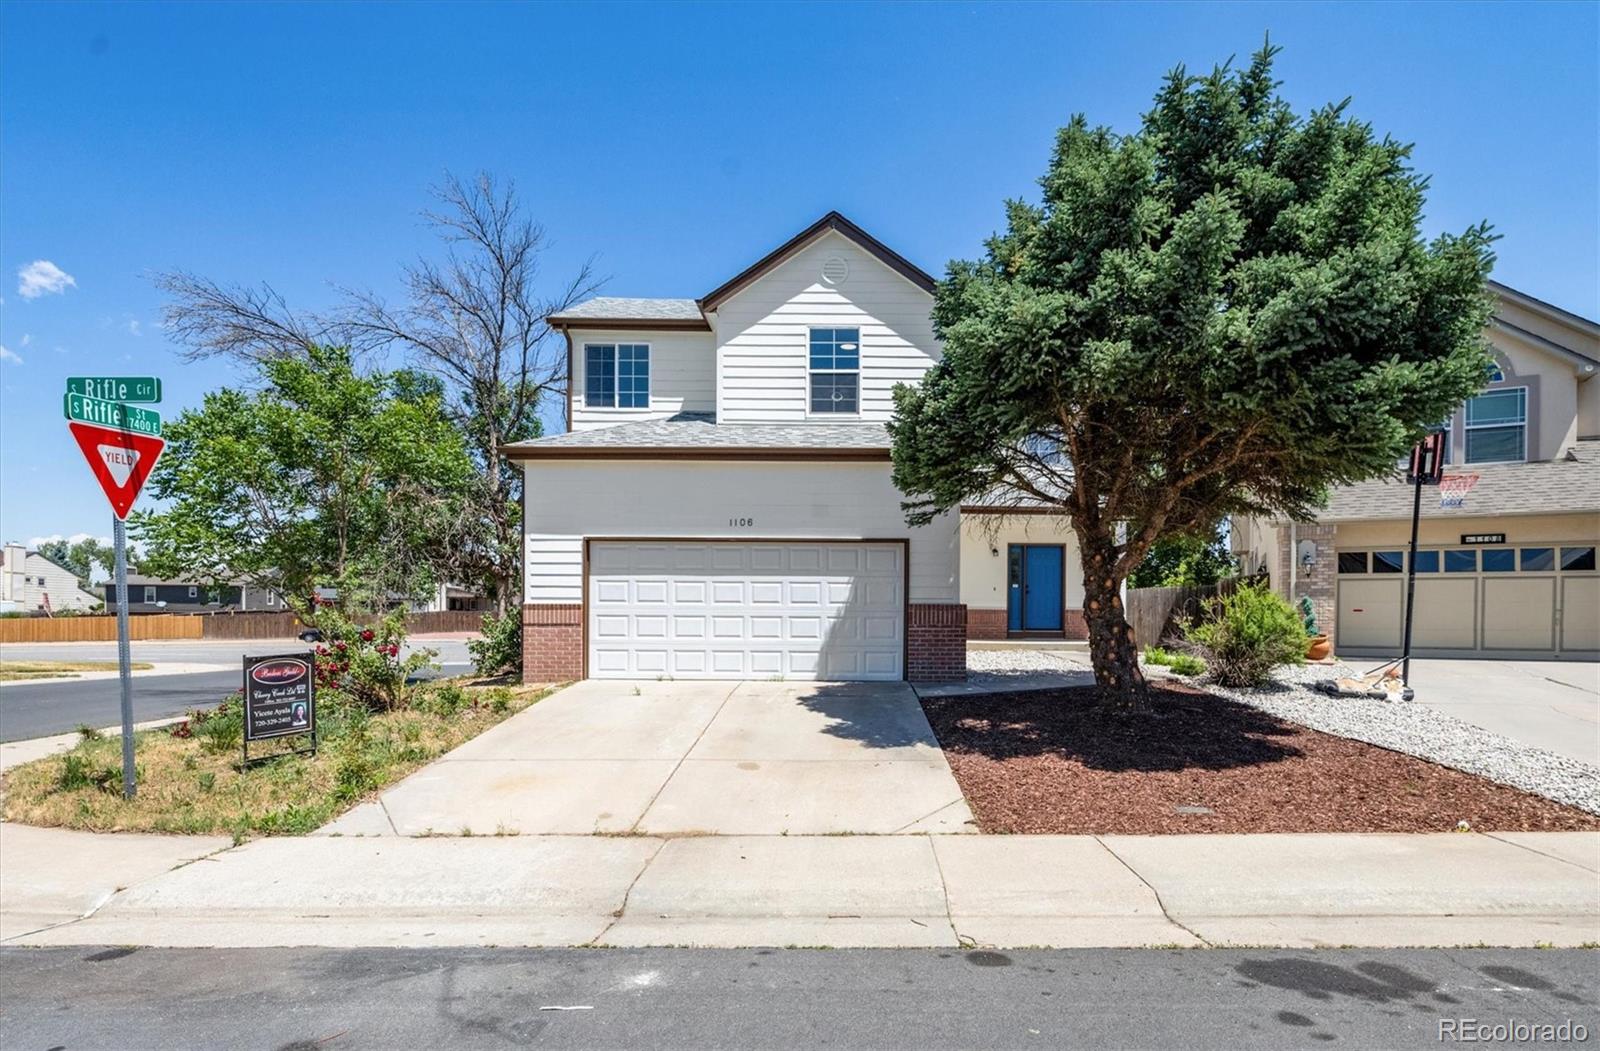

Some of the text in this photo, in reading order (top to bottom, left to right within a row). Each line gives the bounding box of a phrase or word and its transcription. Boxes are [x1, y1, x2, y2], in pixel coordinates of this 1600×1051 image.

[71, 378, 151, 399] S Rifle Cir
[73, 399, 146, 424] S Rifle St
[153, 422, 158, 433] E
[105, 452, 133, 465] YIELD
[729, 518, 753, 527] 1106
